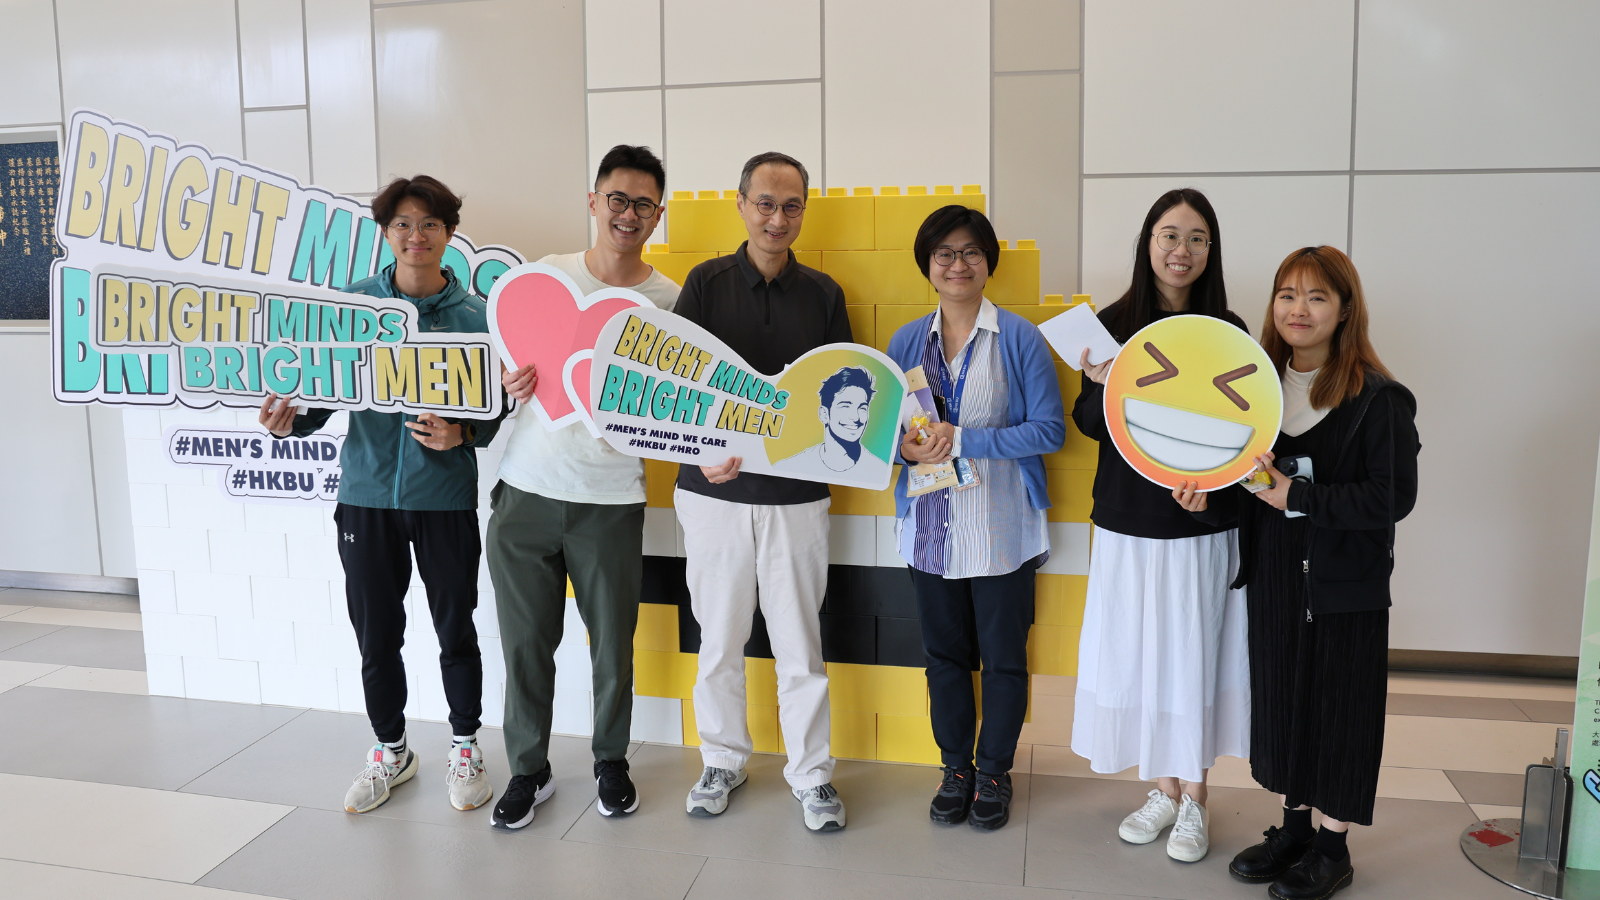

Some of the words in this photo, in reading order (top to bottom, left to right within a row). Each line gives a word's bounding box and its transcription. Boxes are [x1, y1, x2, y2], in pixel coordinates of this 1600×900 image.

[65, 121, 290, 276] BRIGHT
[102, 279, 256, 343] BRIGHT
[267, 298, 404, 343] MINDS
[184, 346, 362, 399] BRIGHT
[375, 347, 486, 408] MEN
[614, 314, 713, 382] BRIGHT
[707, 360, 790, 410] MINDS
[598, 364, 715, 427] BRIGHT
[716, 399, 785, 438] MEN
[175, 436, 263, 459] #MEN'S
[271, 439, 337, 461] MIND
[605, 423, 647, 436] #MEN'S
[649, 429, 680, 441] MIND
[682, 434, 698, 443] WE
[701, 436, 727, 447] CARE
[628, 438, 667, 451] #HKBU
[669, 444, 701, 455] #HRO
[232, 469, 315, 492] #HKBU
